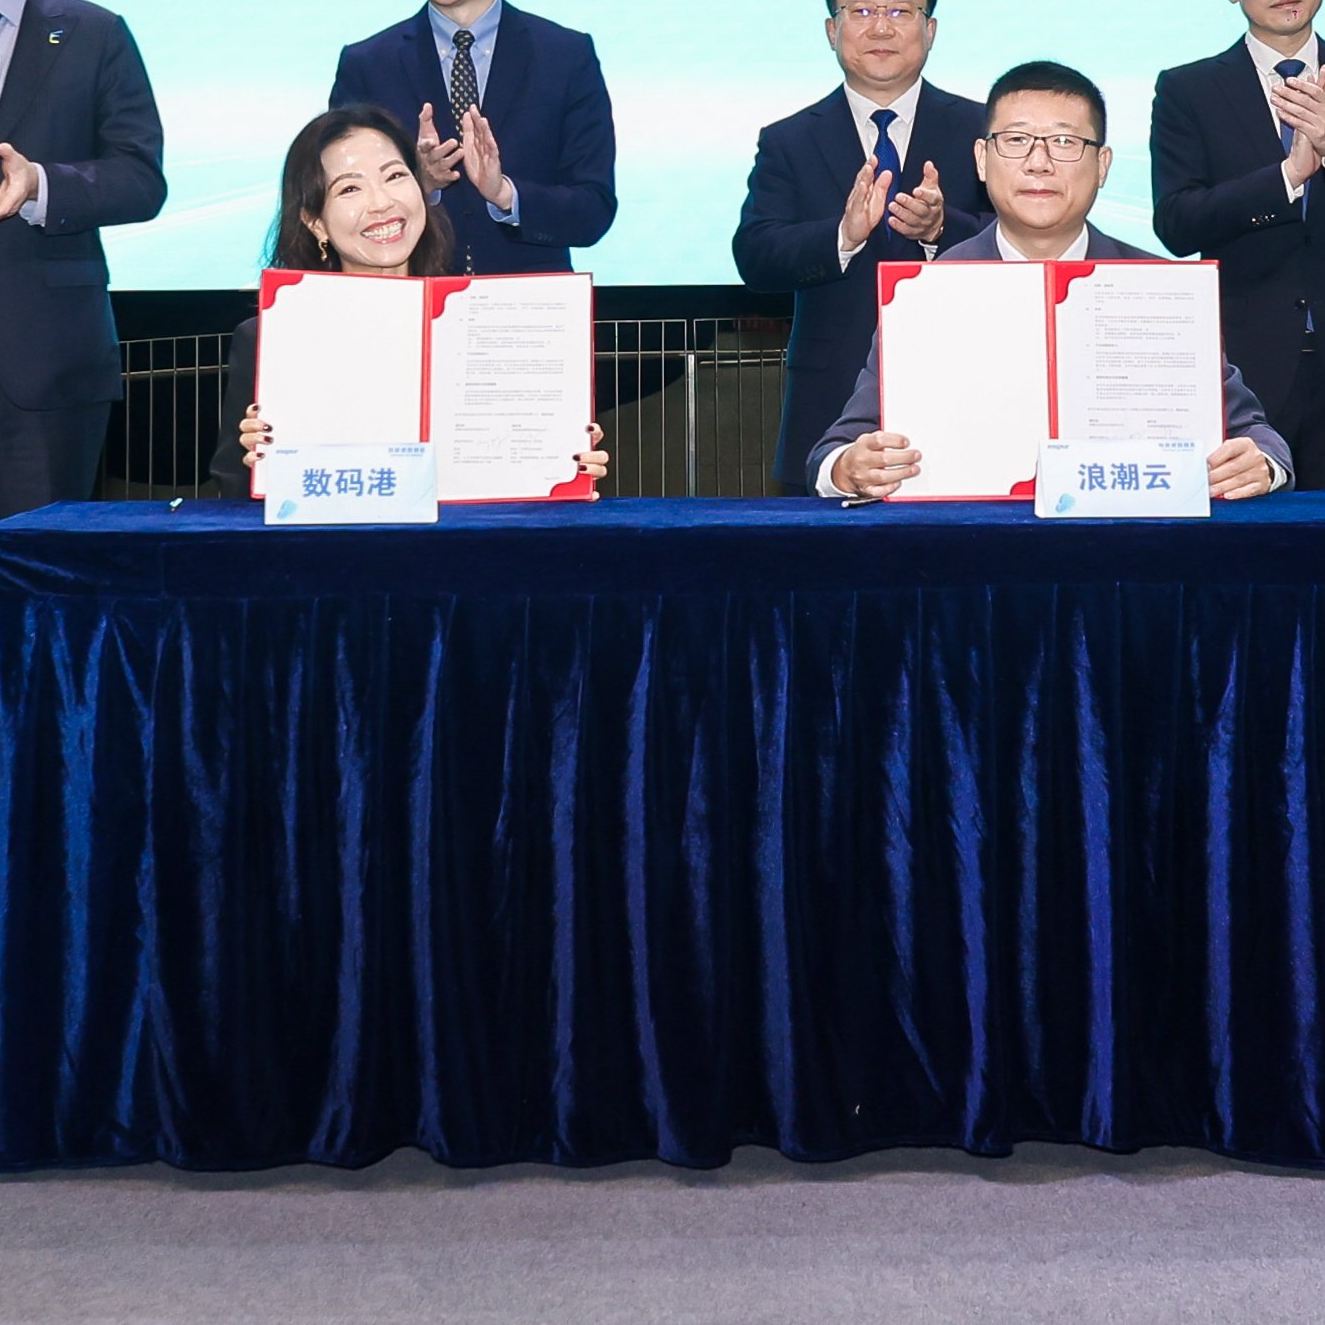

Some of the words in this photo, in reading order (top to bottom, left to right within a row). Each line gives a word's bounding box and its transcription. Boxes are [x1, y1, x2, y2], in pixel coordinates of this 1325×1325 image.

[302, 468, 397, 497] 数码港
[1077, 462, 1172, 491] 浪潮云
